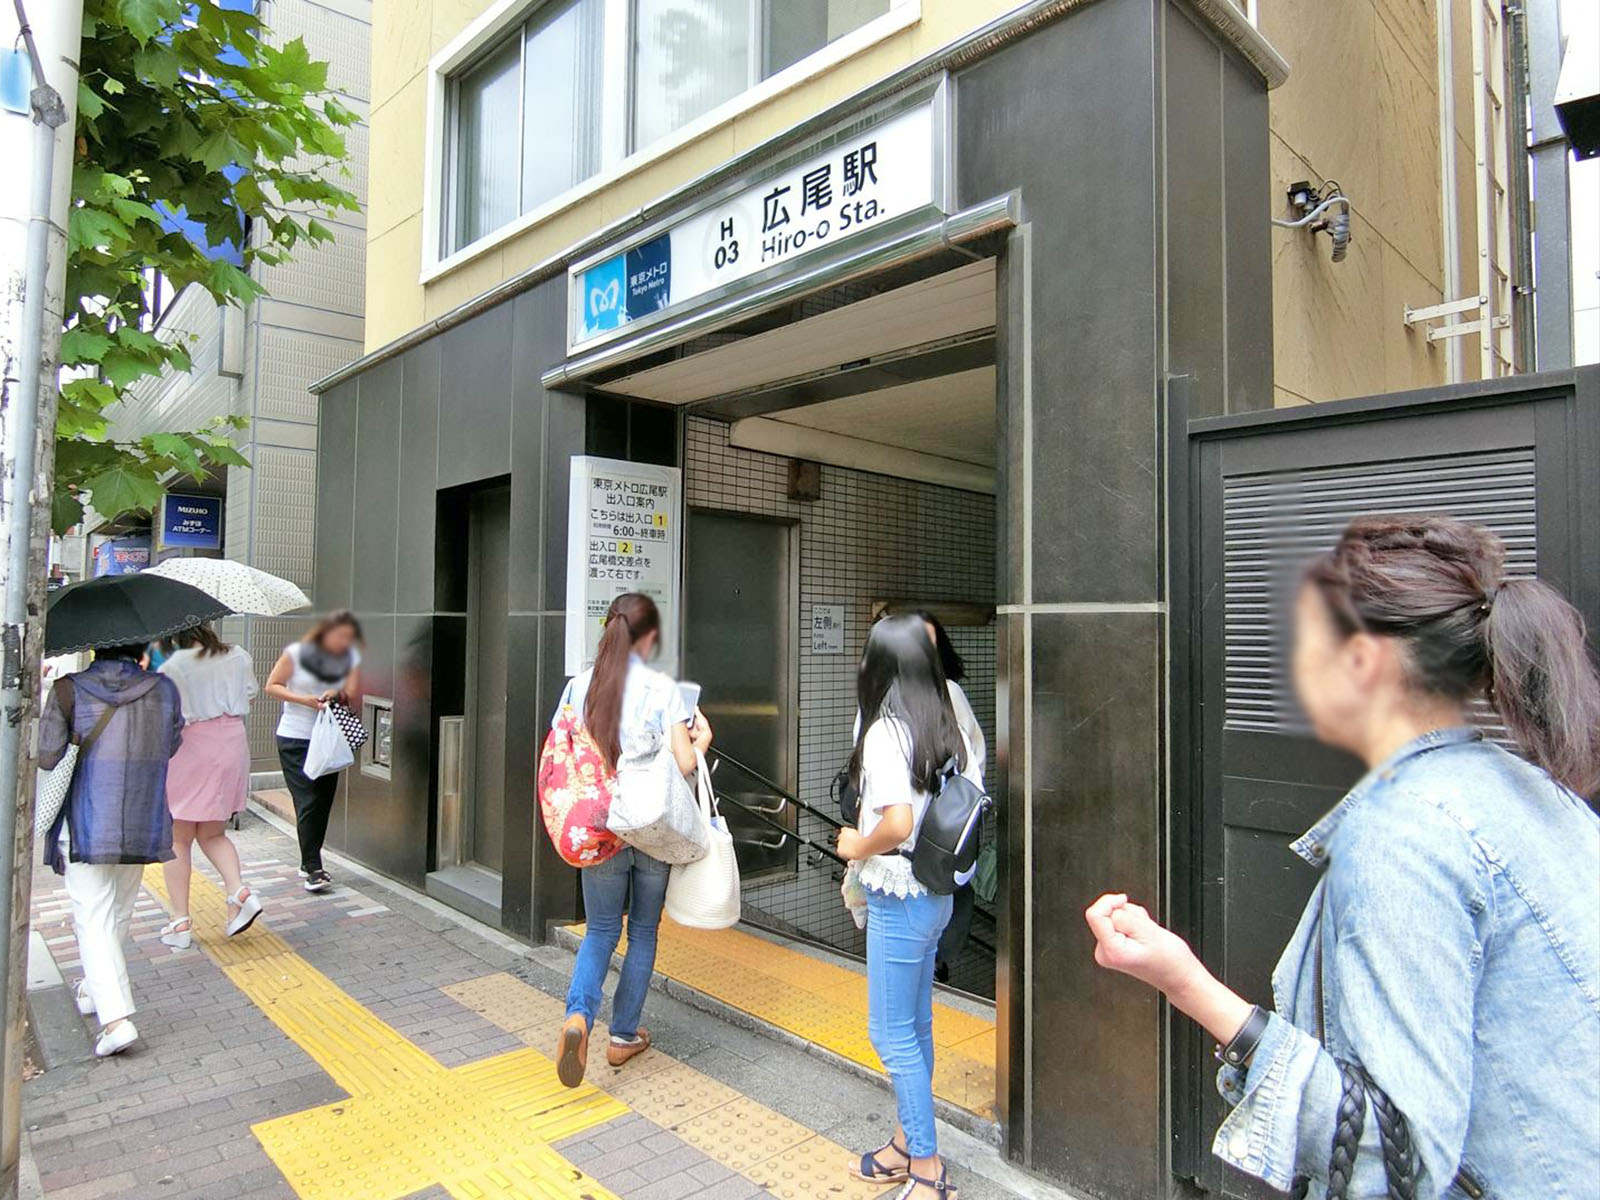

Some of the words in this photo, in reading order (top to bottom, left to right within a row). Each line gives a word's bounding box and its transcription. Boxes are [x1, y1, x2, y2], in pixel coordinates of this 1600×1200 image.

[762, 141, 878, 234] 広尾駅
[721, 217, 733, 241] H
[761, 220, 830, 263] Hiro-o
[839, 196, 885, 230] Sta.
[714, 240, 739, 270] 03
[630, 262, 668, 286] 東京メトロ
[631, 284, 648, 296] Tokyo
[648, 278, 665, 288] Metro
[593, 478, 668, 498] 東京メトロ広尾駅
[177, 506, 209, 515] MIZUHO
[606, 494, 655, 510] 出入口案内
[591, 508, 653, 525] こちらは出入口
[658, 515, 663, 526] 1
[172, 526, 212, 534] ATMコーナー
[590, 541, 617, 553] 出入口
[622, 543, 628, 553] 2
[635, 544, 642, 554] は
[590, 553, 651, 568] 広尾橋交差点を
[589, 567, 645, 580] 渡って右です。
[814, 641, 827, 650] Left
